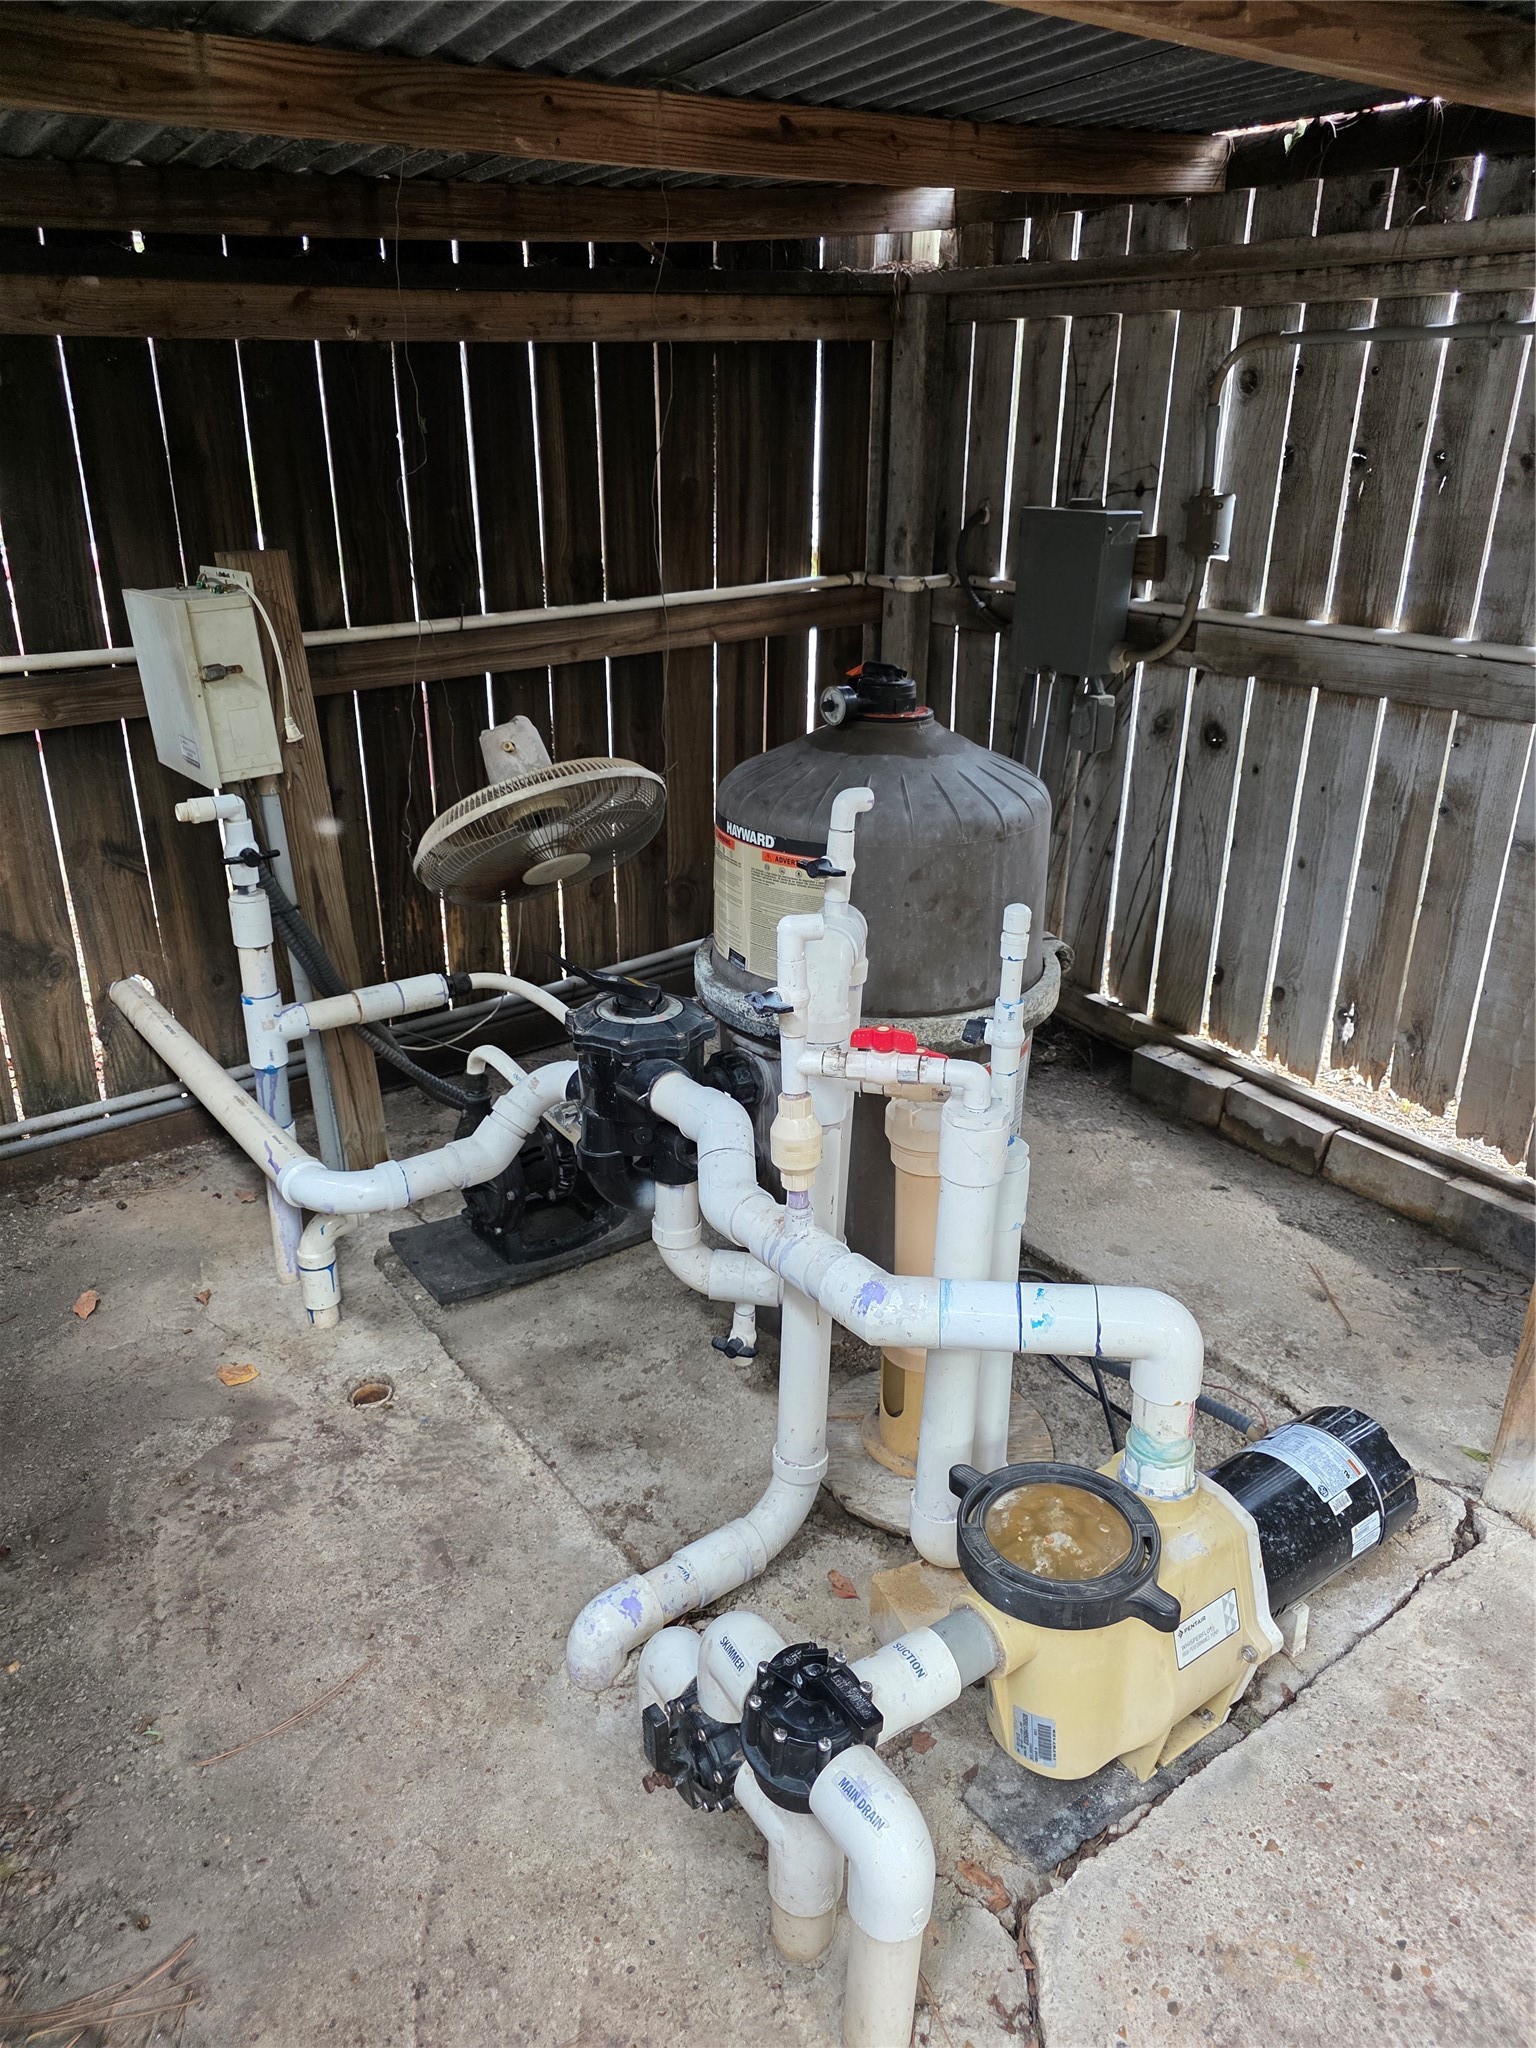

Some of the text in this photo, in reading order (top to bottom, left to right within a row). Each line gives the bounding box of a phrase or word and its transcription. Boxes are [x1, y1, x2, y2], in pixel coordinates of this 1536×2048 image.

[726, 820, 775, 849] HAYWARD
[1183, 1615, 1206, 1633] PENTAIR
[720, 1636, 745, 1672] SKIMMER
[892, 1642, 926, 1678] SUCTION
[837, 1776, 886, 1832] MAIN DRAIN
